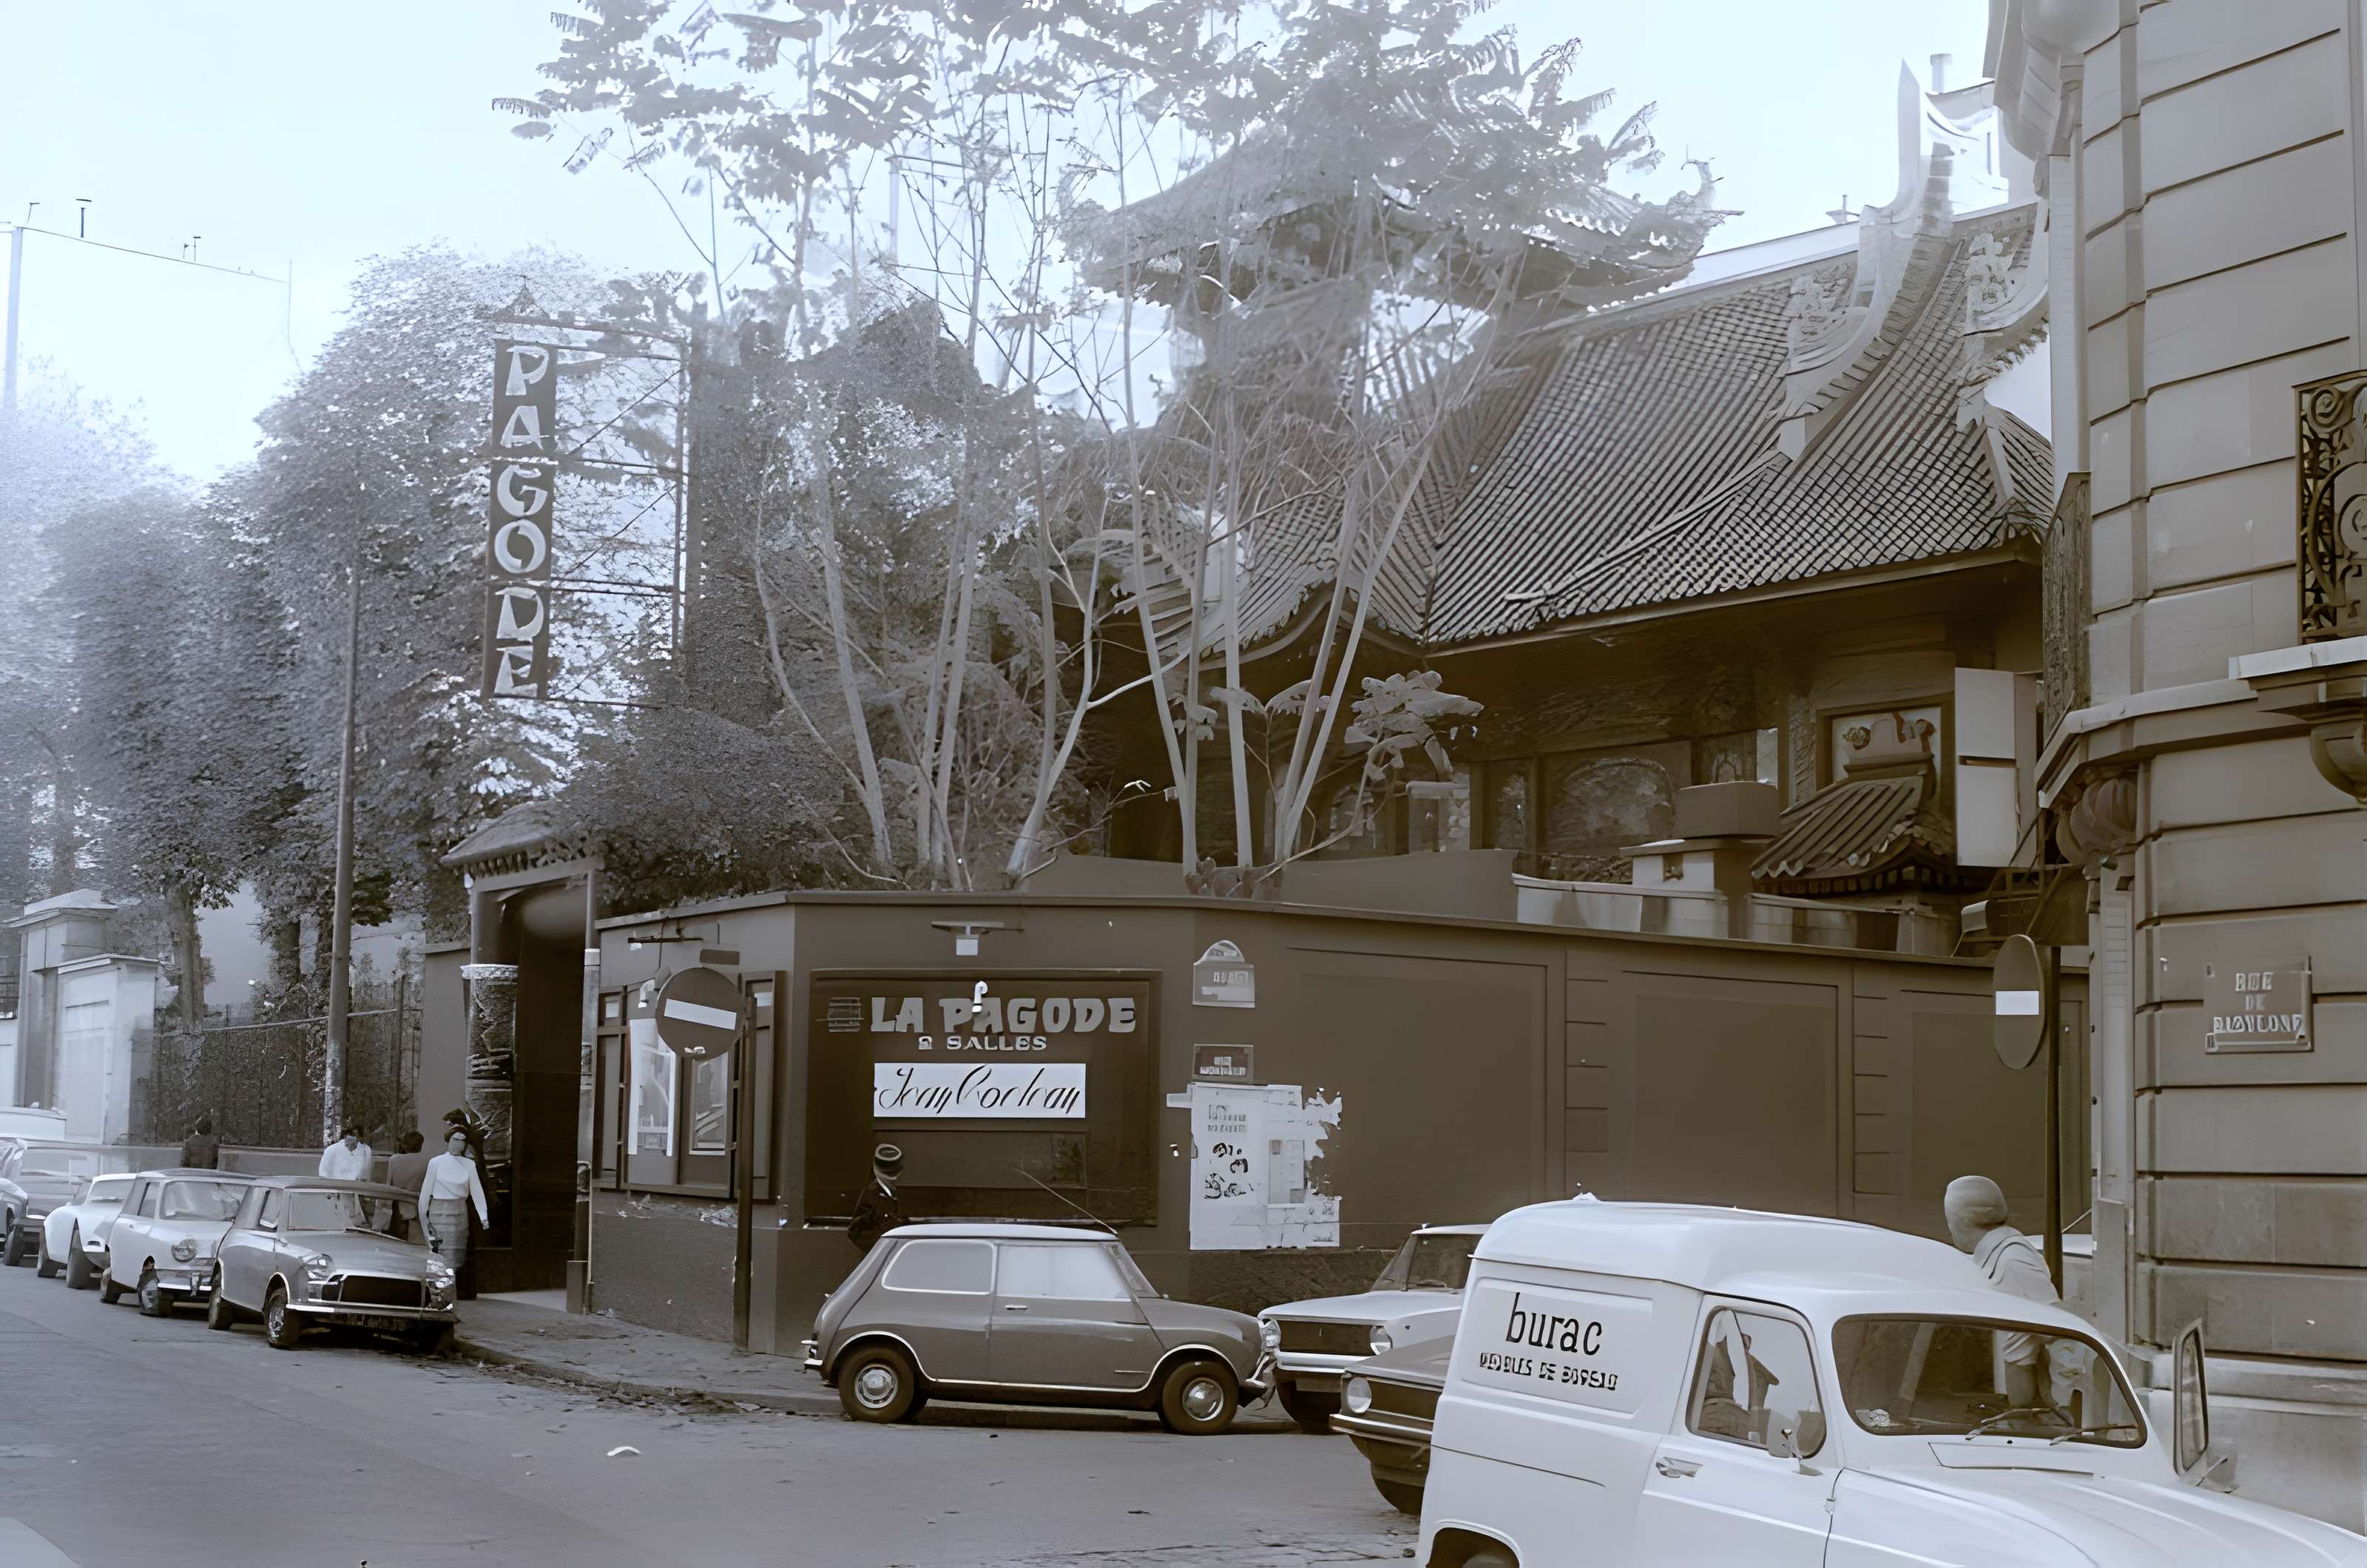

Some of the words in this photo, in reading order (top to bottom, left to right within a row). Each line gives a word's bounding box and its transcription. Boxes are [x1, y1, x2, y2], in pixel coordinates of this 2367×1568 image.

[493, 345, 550, 697] PAGODE
[871, 997, 924, 1033] LA
[939, 997, 1136, 1033] PAGODE
[946, 1035, 1048, 1051] SALLES
[1505, 1291, 1603, 1356] burac
